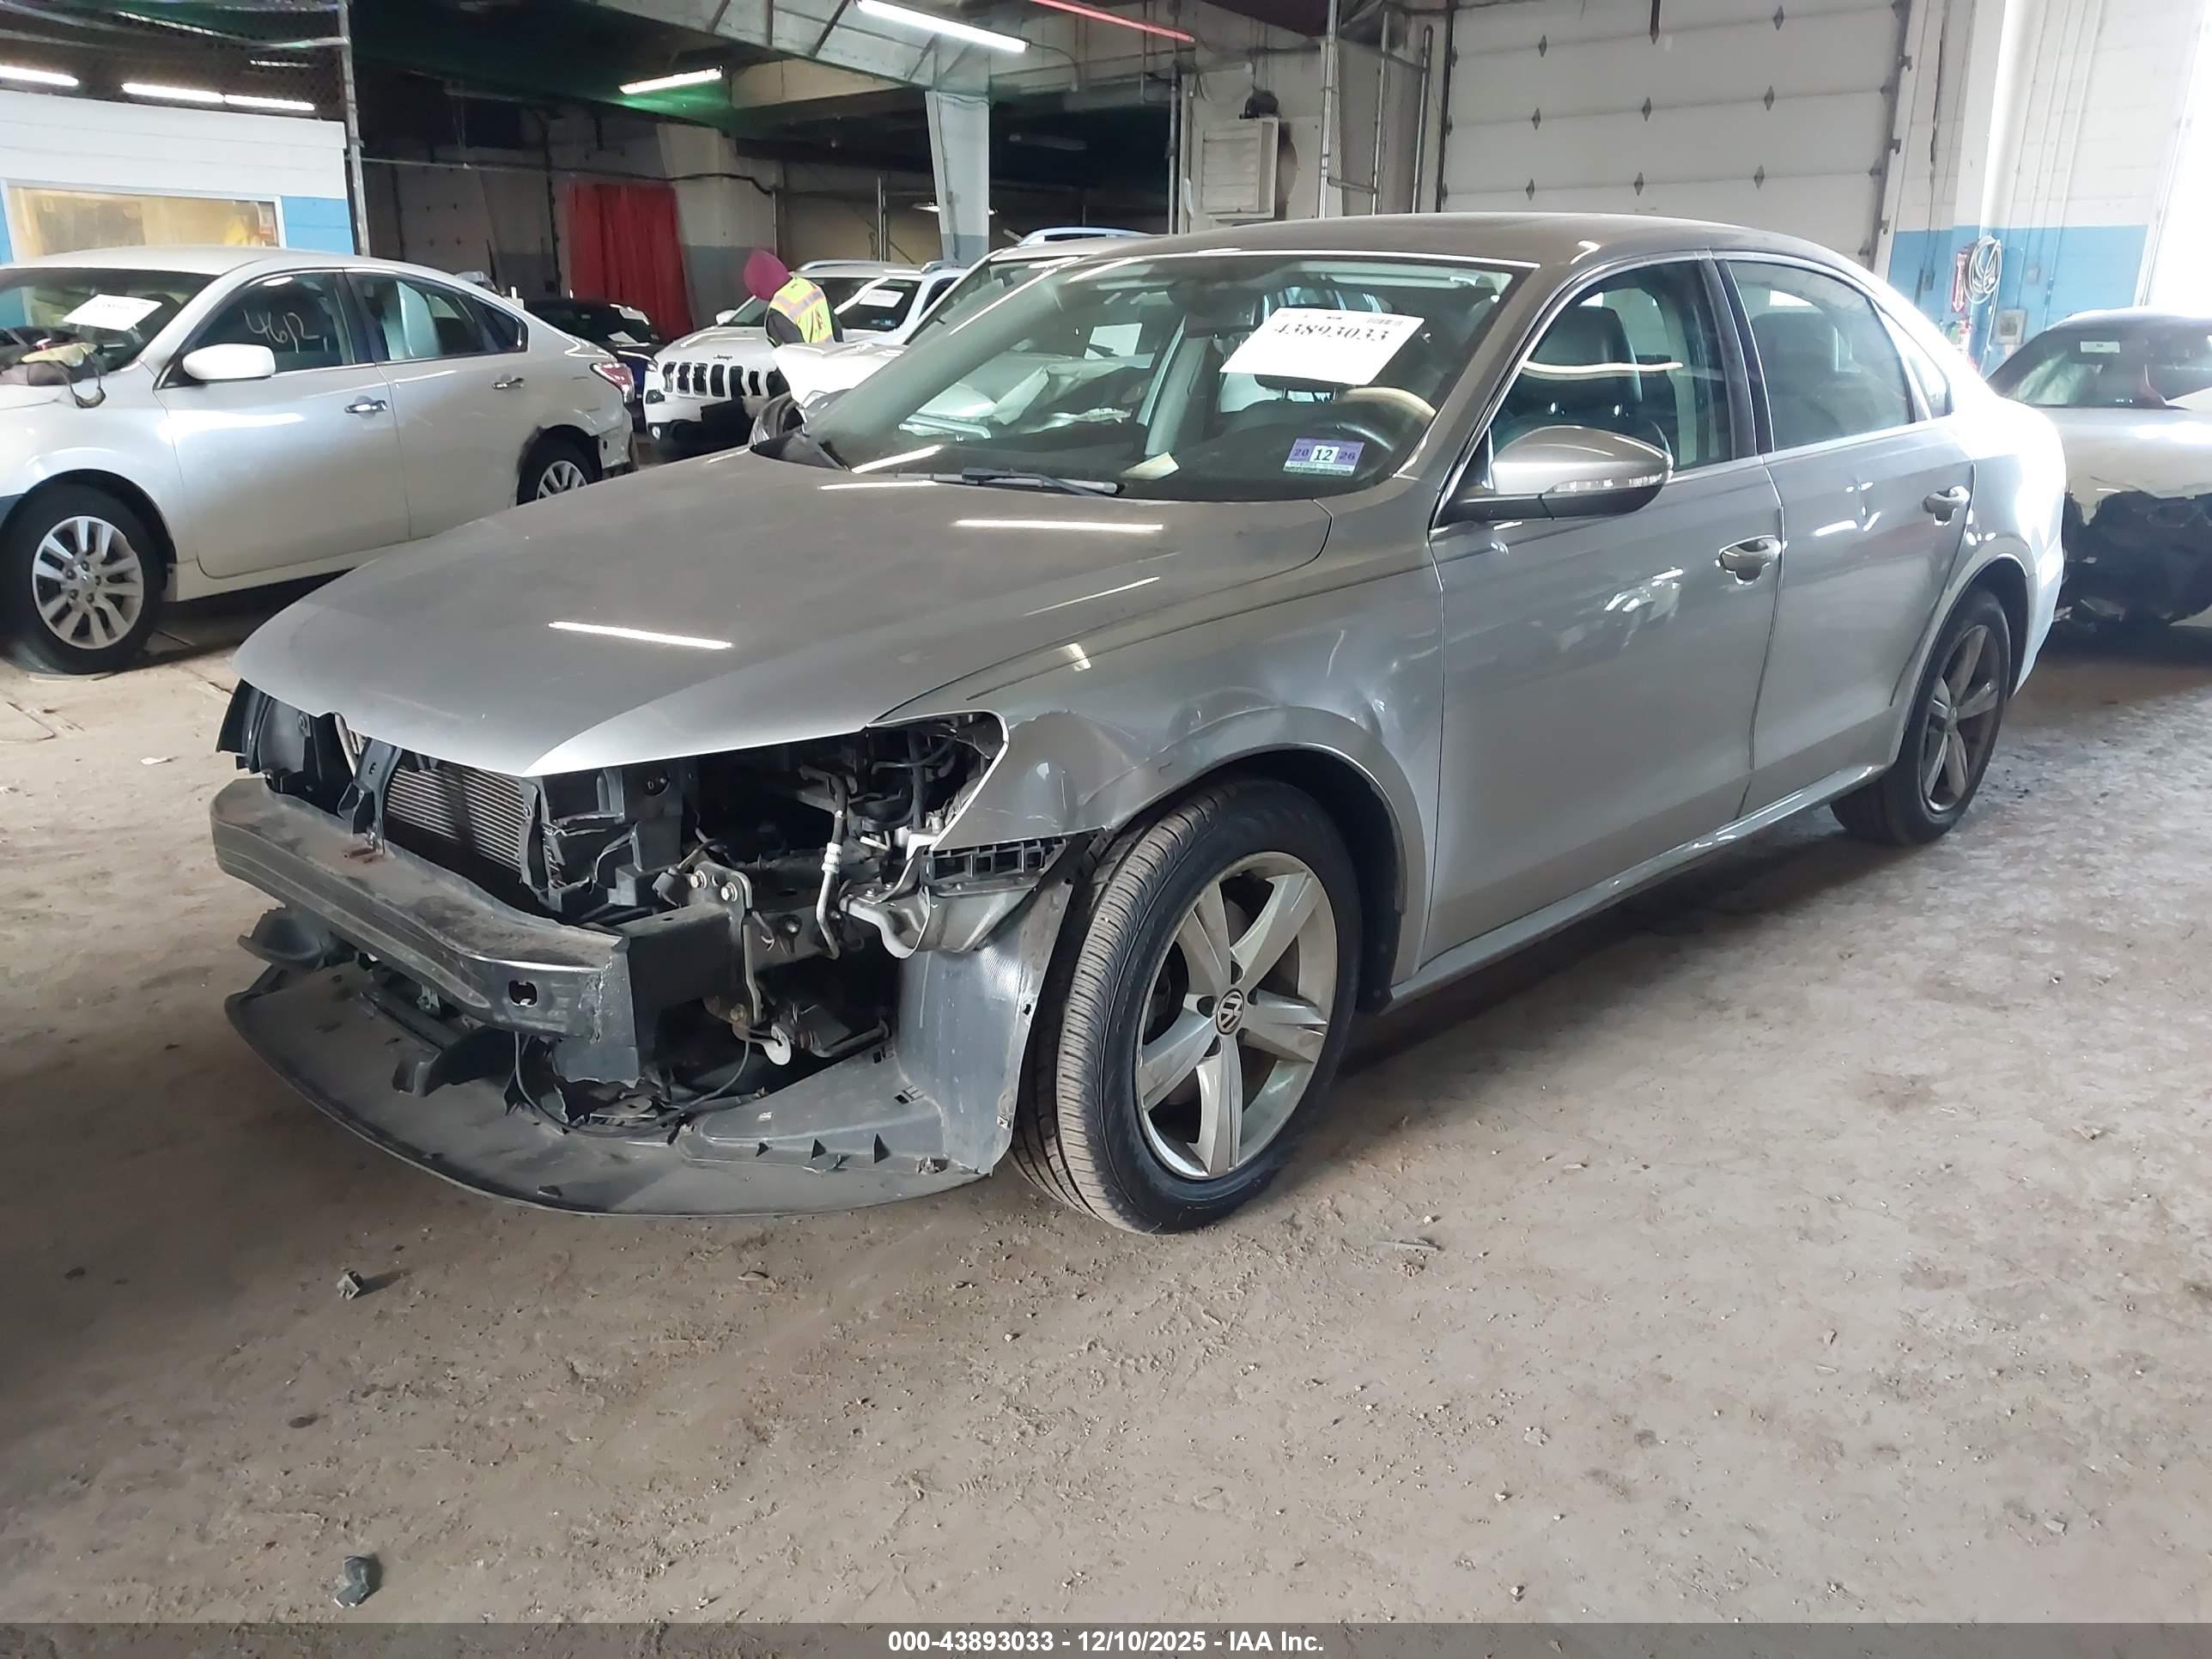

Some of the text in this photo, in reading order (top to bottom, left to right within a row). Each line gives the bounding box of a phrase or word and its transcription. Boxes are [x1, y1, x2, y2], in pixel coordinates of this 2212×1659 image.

[243, 309, 319, 354] 4612
[1273, 324, 1390, 342] 43893033
[1293, 448, 1356, 461] 20 12 26
